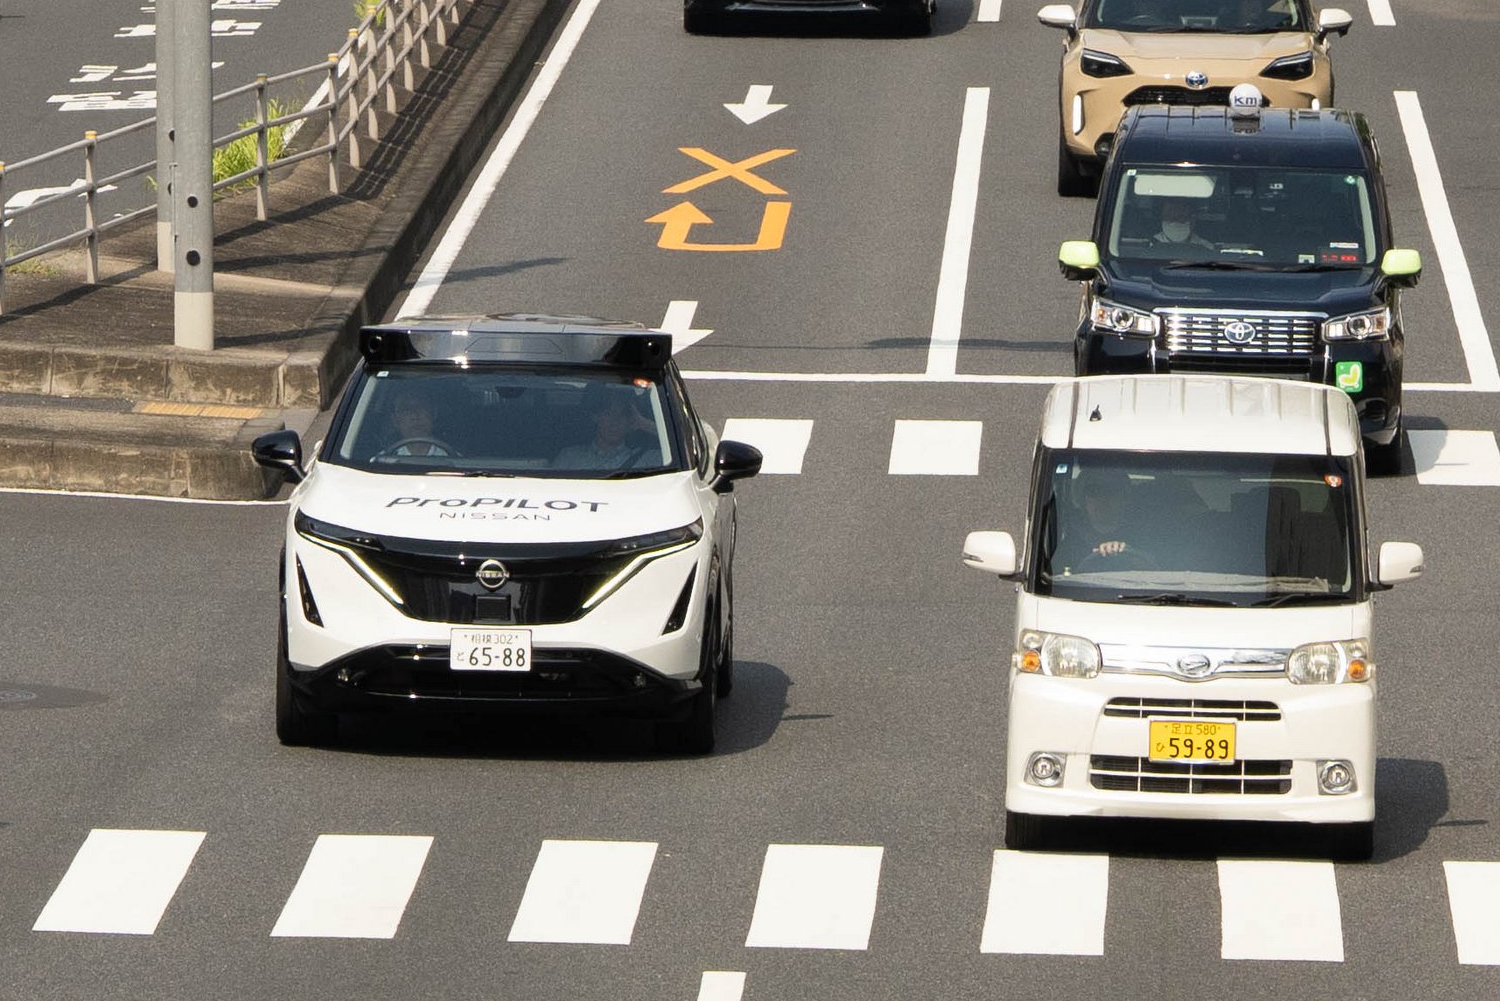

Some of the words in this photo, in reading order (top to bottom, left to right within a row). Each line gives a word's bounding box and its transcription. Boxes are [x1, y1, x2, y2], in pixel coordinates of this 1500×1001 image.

[439, 511, 551, 521] NISSAN
[475, 570, 510, 579] NISSAN
[468, 647, 527, 667] 65-88
[1168, 737, 1229, 760] 59-89
